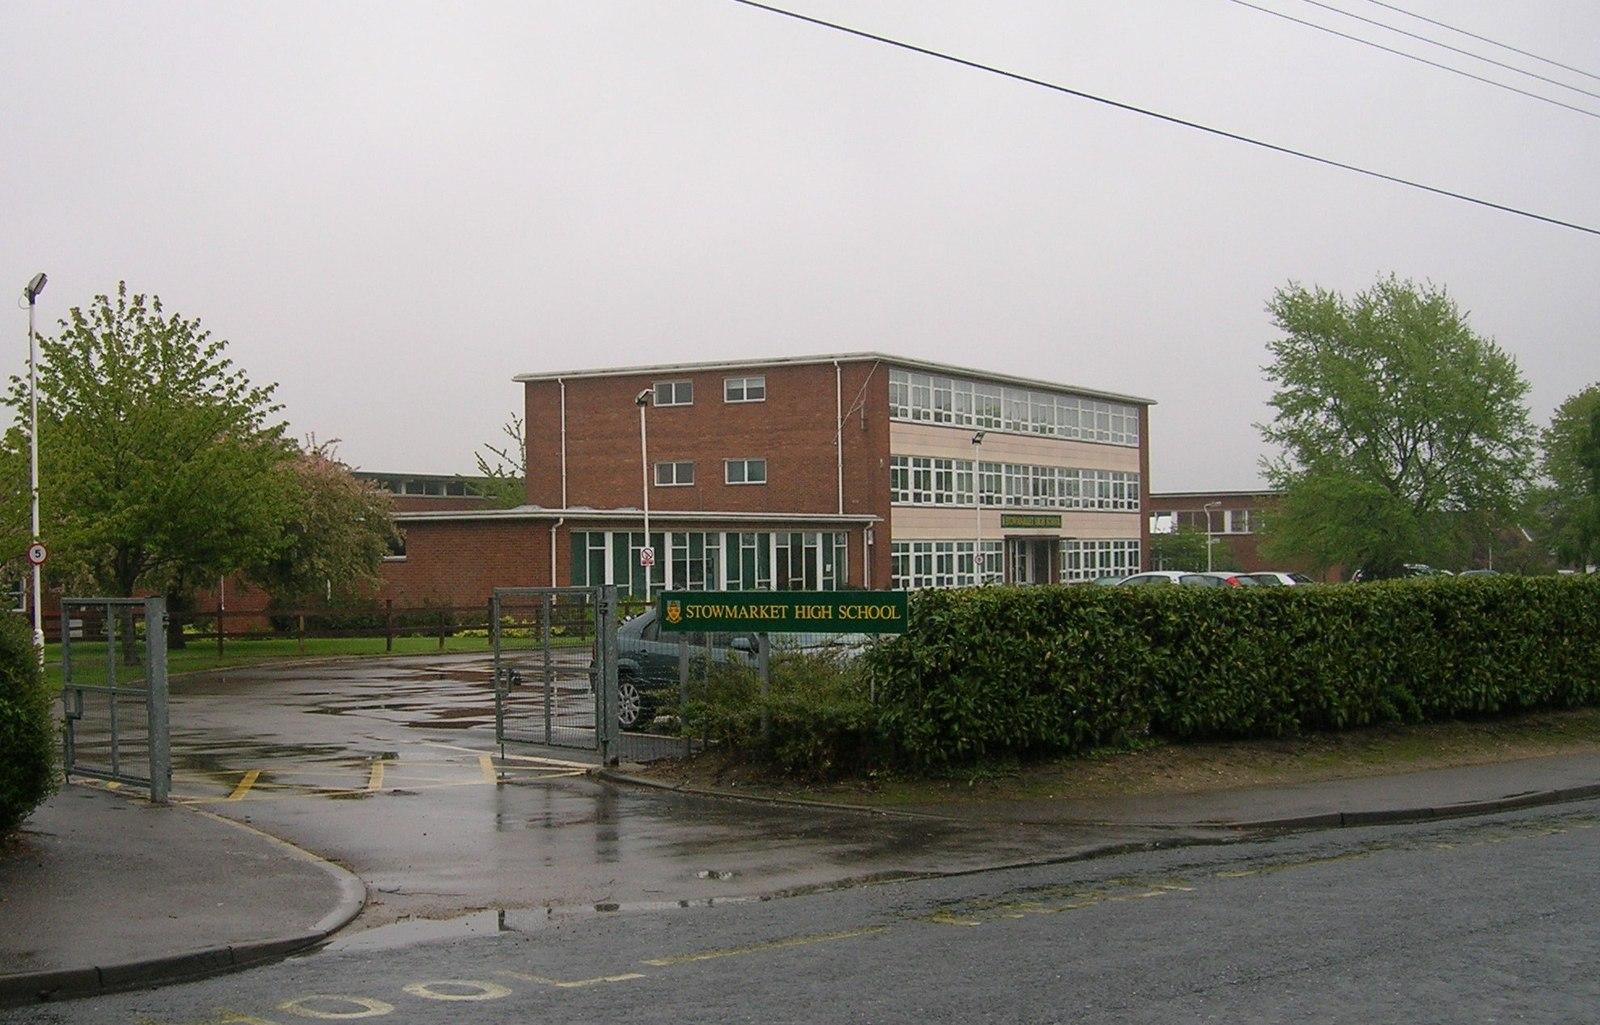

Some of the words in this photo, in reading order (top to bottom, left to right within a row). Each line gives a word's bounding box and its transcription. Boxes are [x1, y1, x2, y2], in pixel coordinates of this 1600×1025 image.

[35, 549, 42, 558] 5
[686, 605, 789, 619] STOWMARKET
[794, 605, 833, 619] HIGH
[838, 605, 901, 620] SCHOOL
